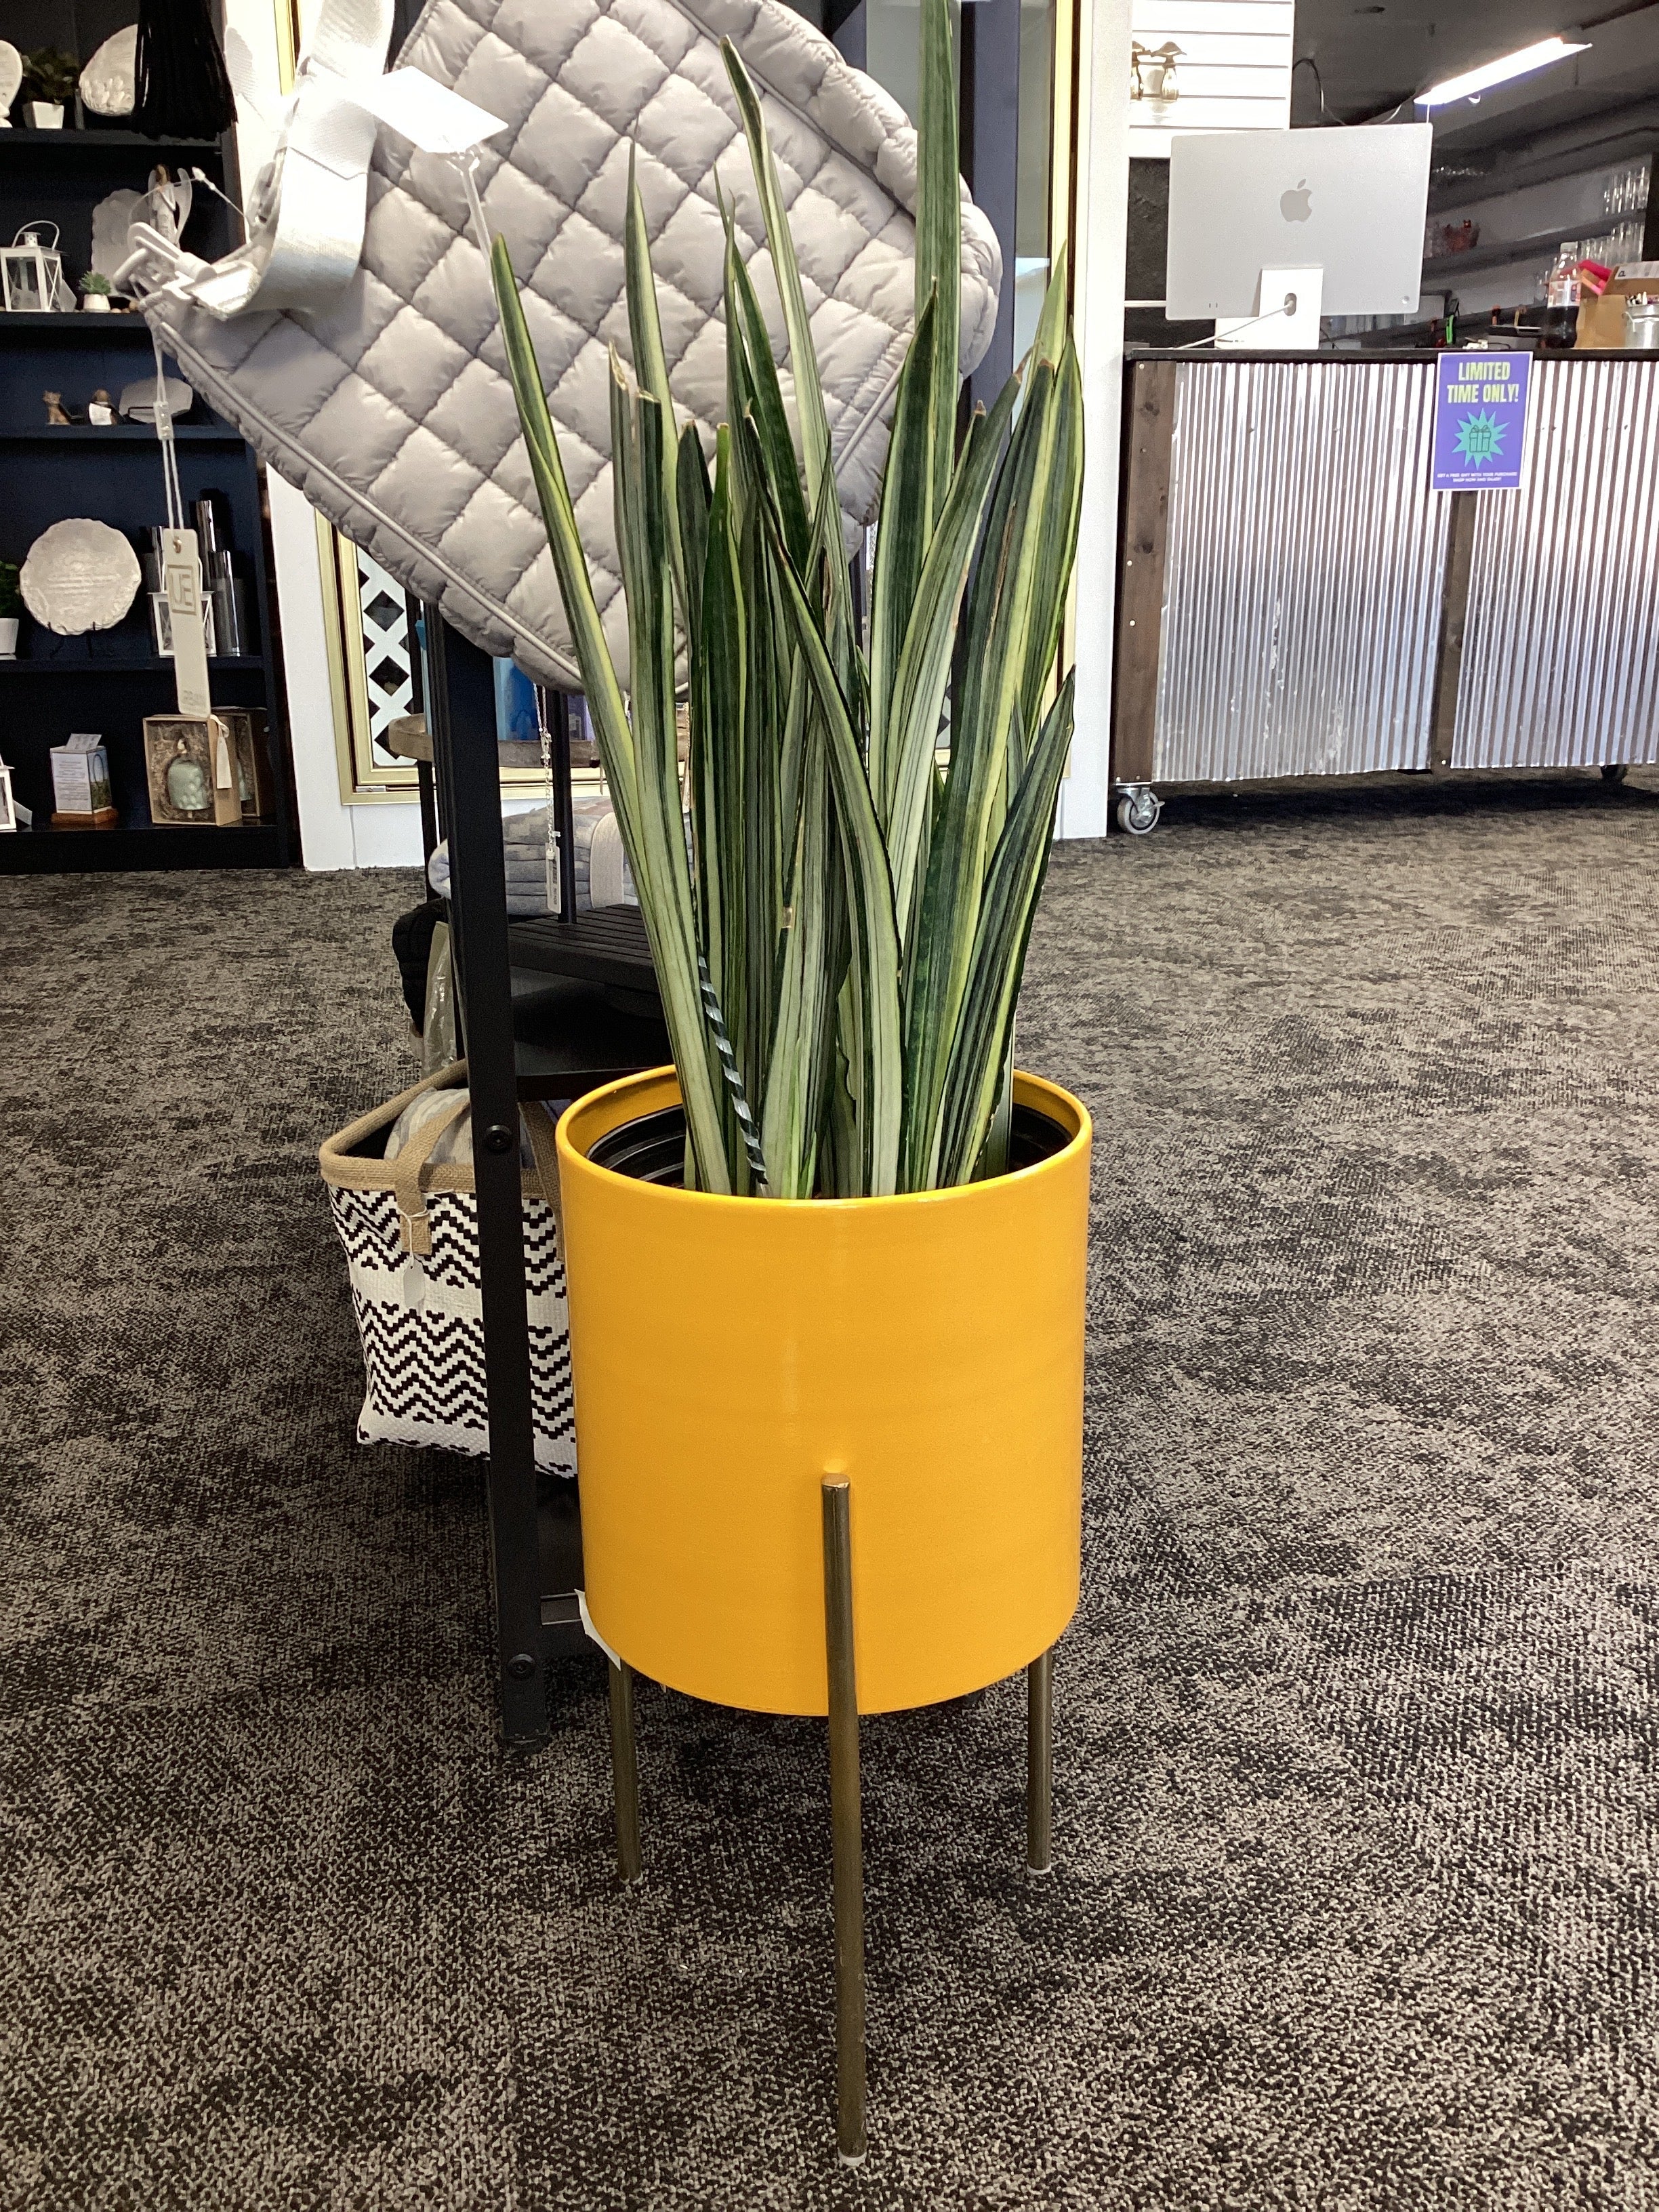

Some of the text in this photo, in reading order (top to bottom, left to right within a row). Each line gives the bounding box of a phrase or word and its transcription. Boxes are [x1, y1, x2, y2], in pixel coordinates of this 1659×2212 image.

[1458, 362, 1511, 381] LIMITED
[1447, 384, 1519, 403] TIME ONLY!
